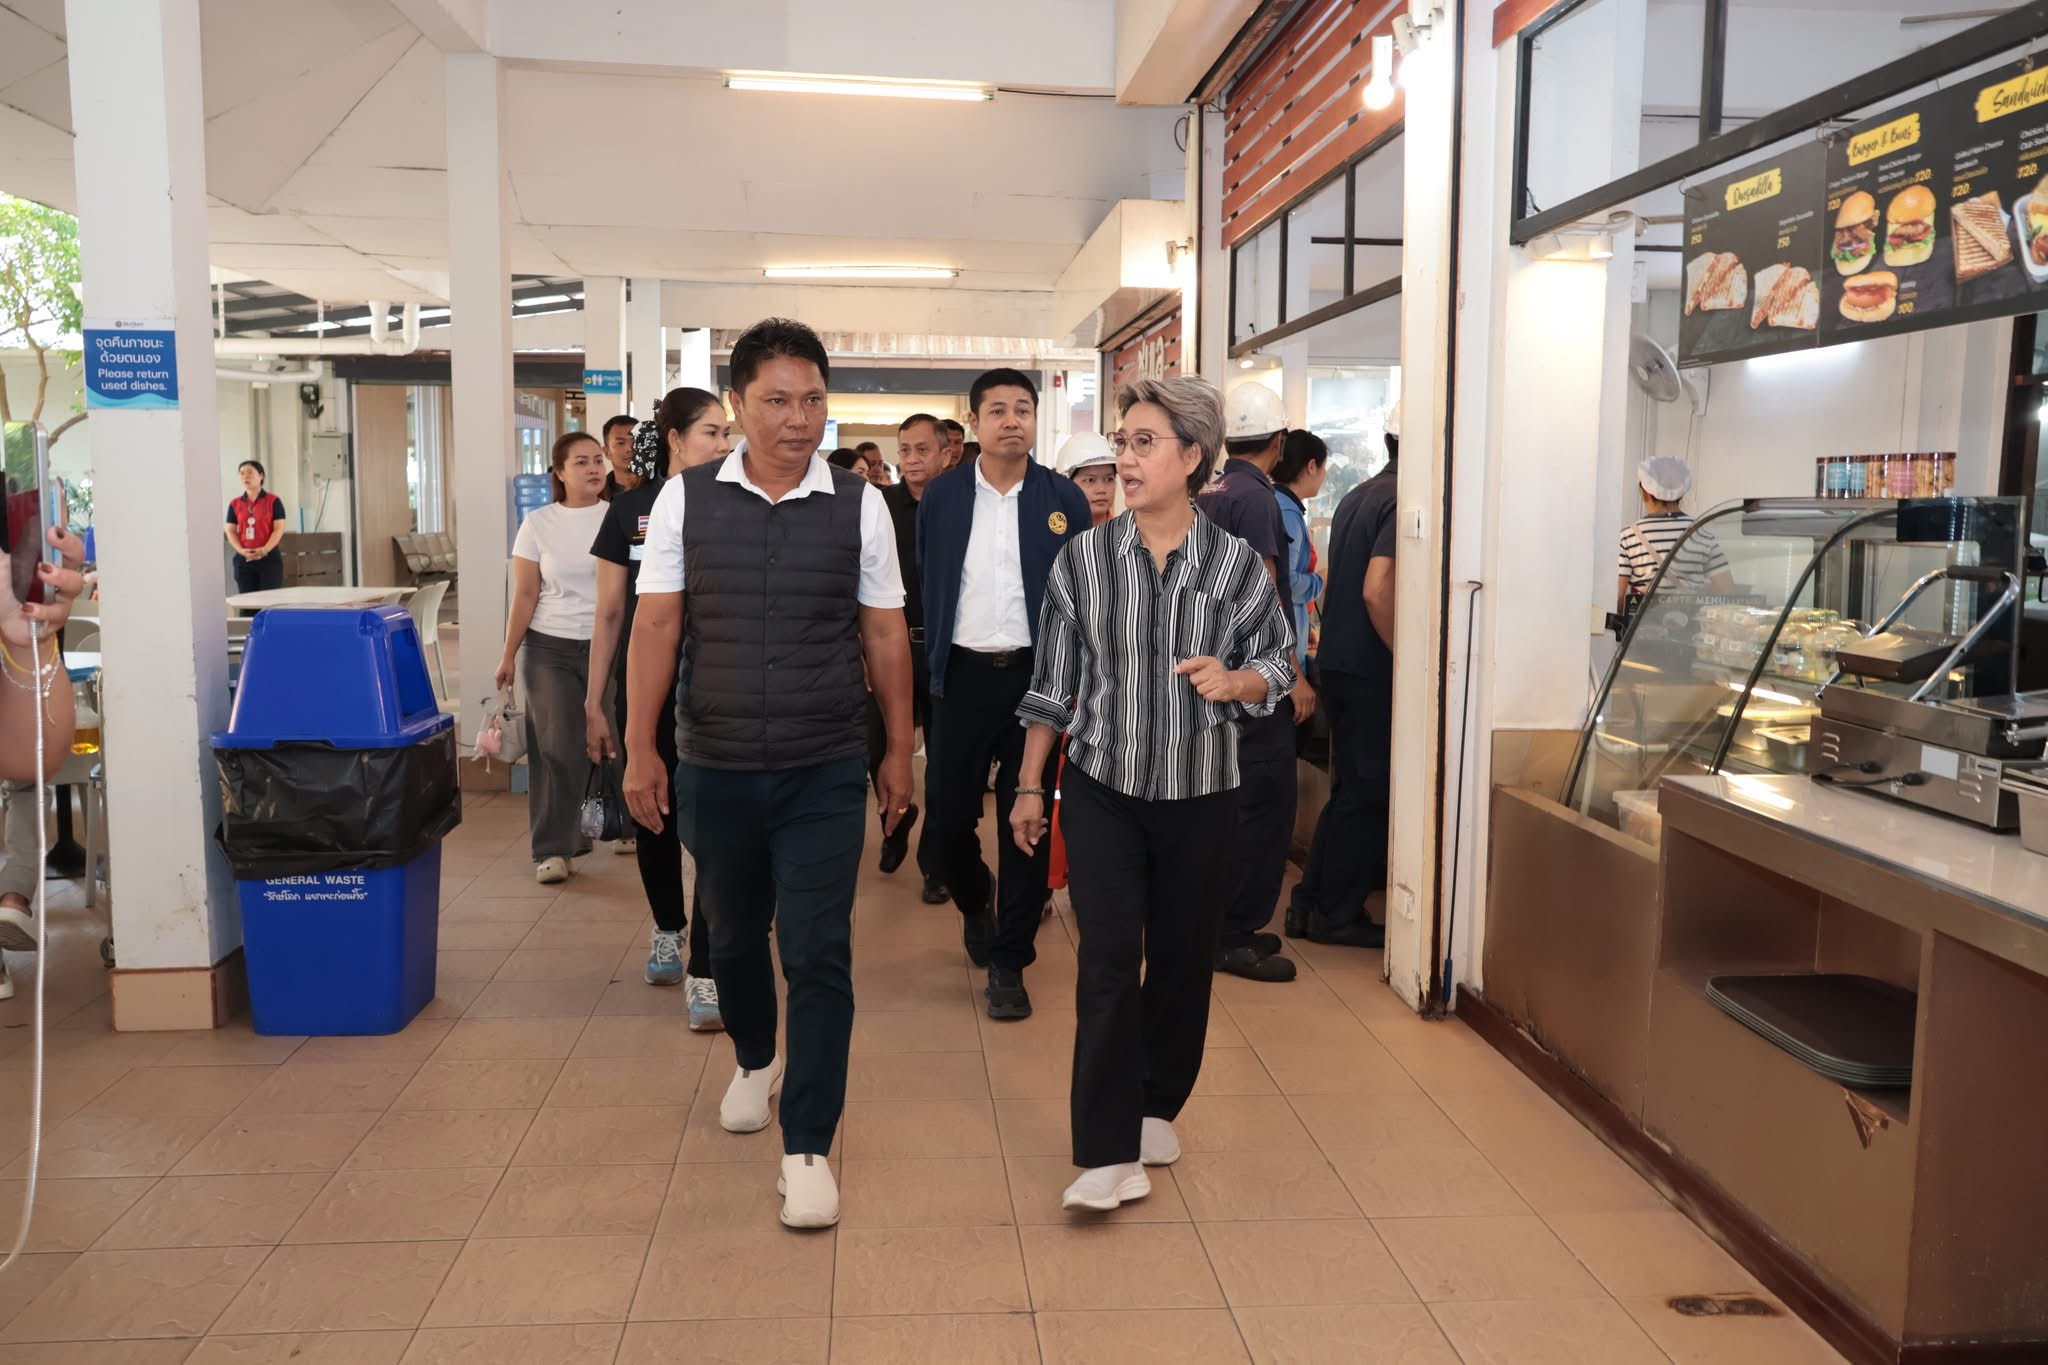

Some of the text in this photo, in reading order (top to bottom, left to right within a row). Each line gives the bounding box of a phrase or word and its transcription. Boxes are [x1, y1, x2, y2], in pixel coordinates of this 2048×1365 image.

[1852, 139, 1878, 158] Burger
[1733, 174, 1773, 206] Quesadilla
[96, 336, 165, 351] จุดคืนภาชนะ
[100, 350, 161, 363] ด้วยตนเอง
[98, 368, 169, 379] Please return
[101, 381, 168, 391] used dishes.
[1696, 595, 1728, 605] MENU
[266, 876, 365, 885] GENERAL WASTE
